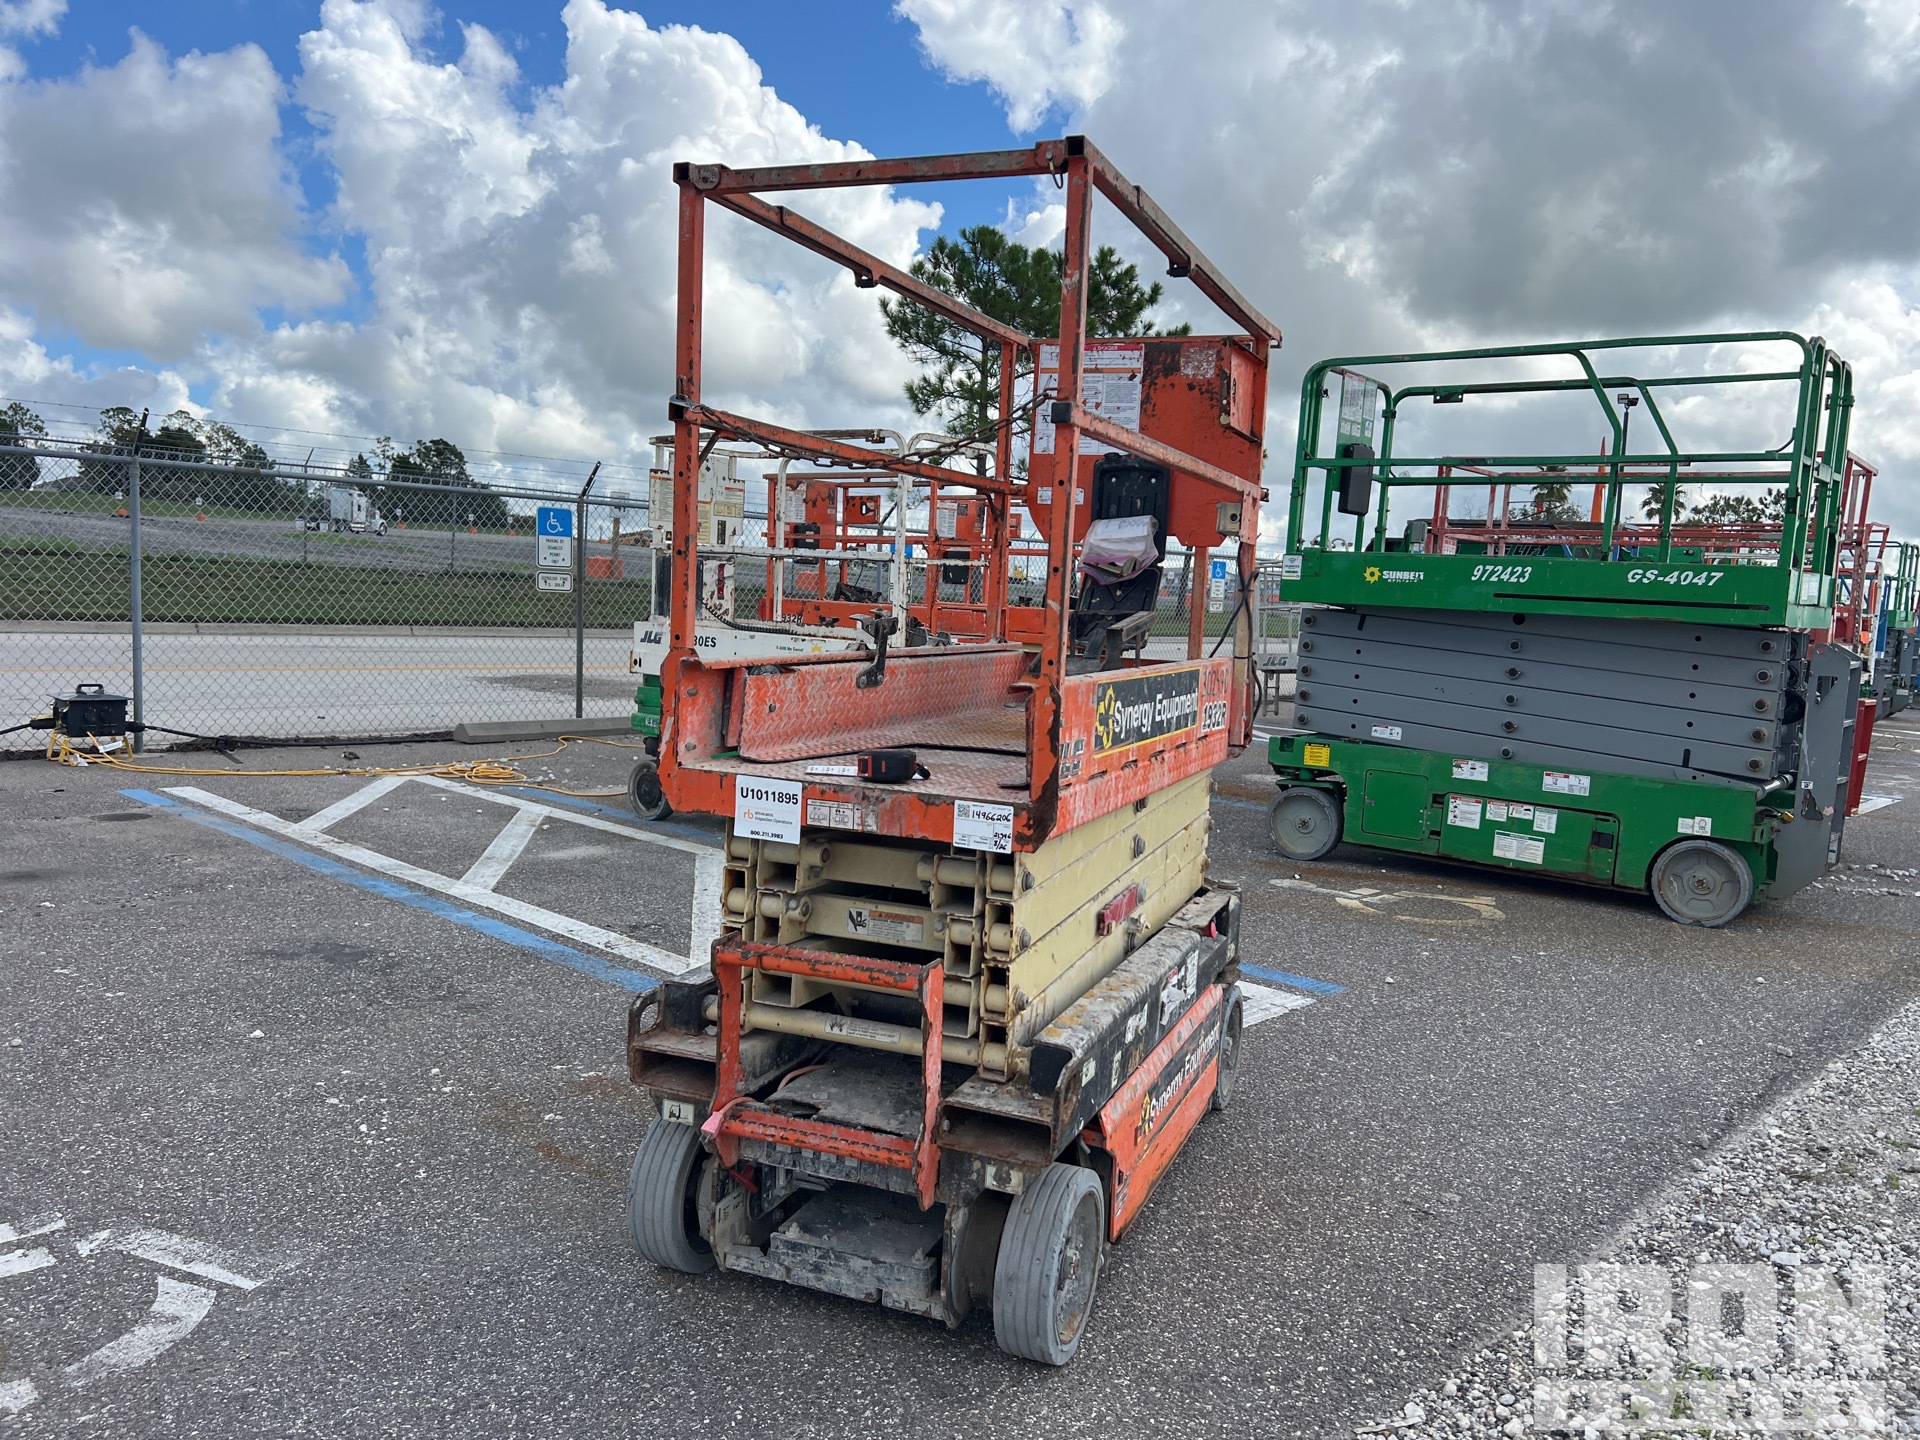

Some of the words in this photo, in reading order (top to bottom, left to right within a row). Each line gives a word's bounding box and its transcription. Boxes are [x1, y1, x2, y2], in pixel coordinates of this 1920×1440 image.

[1512, 544, 1550, 556] LIFT
[1471, 565, 1532, 583] 972423
[1627, 569, 1724, 586] GS-4047
[640, 630, 662, 644] JLG
[1263, 656, 1288, 667] JLG
[1114, 700, 1154, 739] Synergy
[1155, 687, 1198, 727] Equipment
[1202, 701, 1227, 730] 1932R
[740, 786, 799, 805] U1011895
[743, 809, 754, 819] rb
[972, 809, 1012, 822] 14966206
